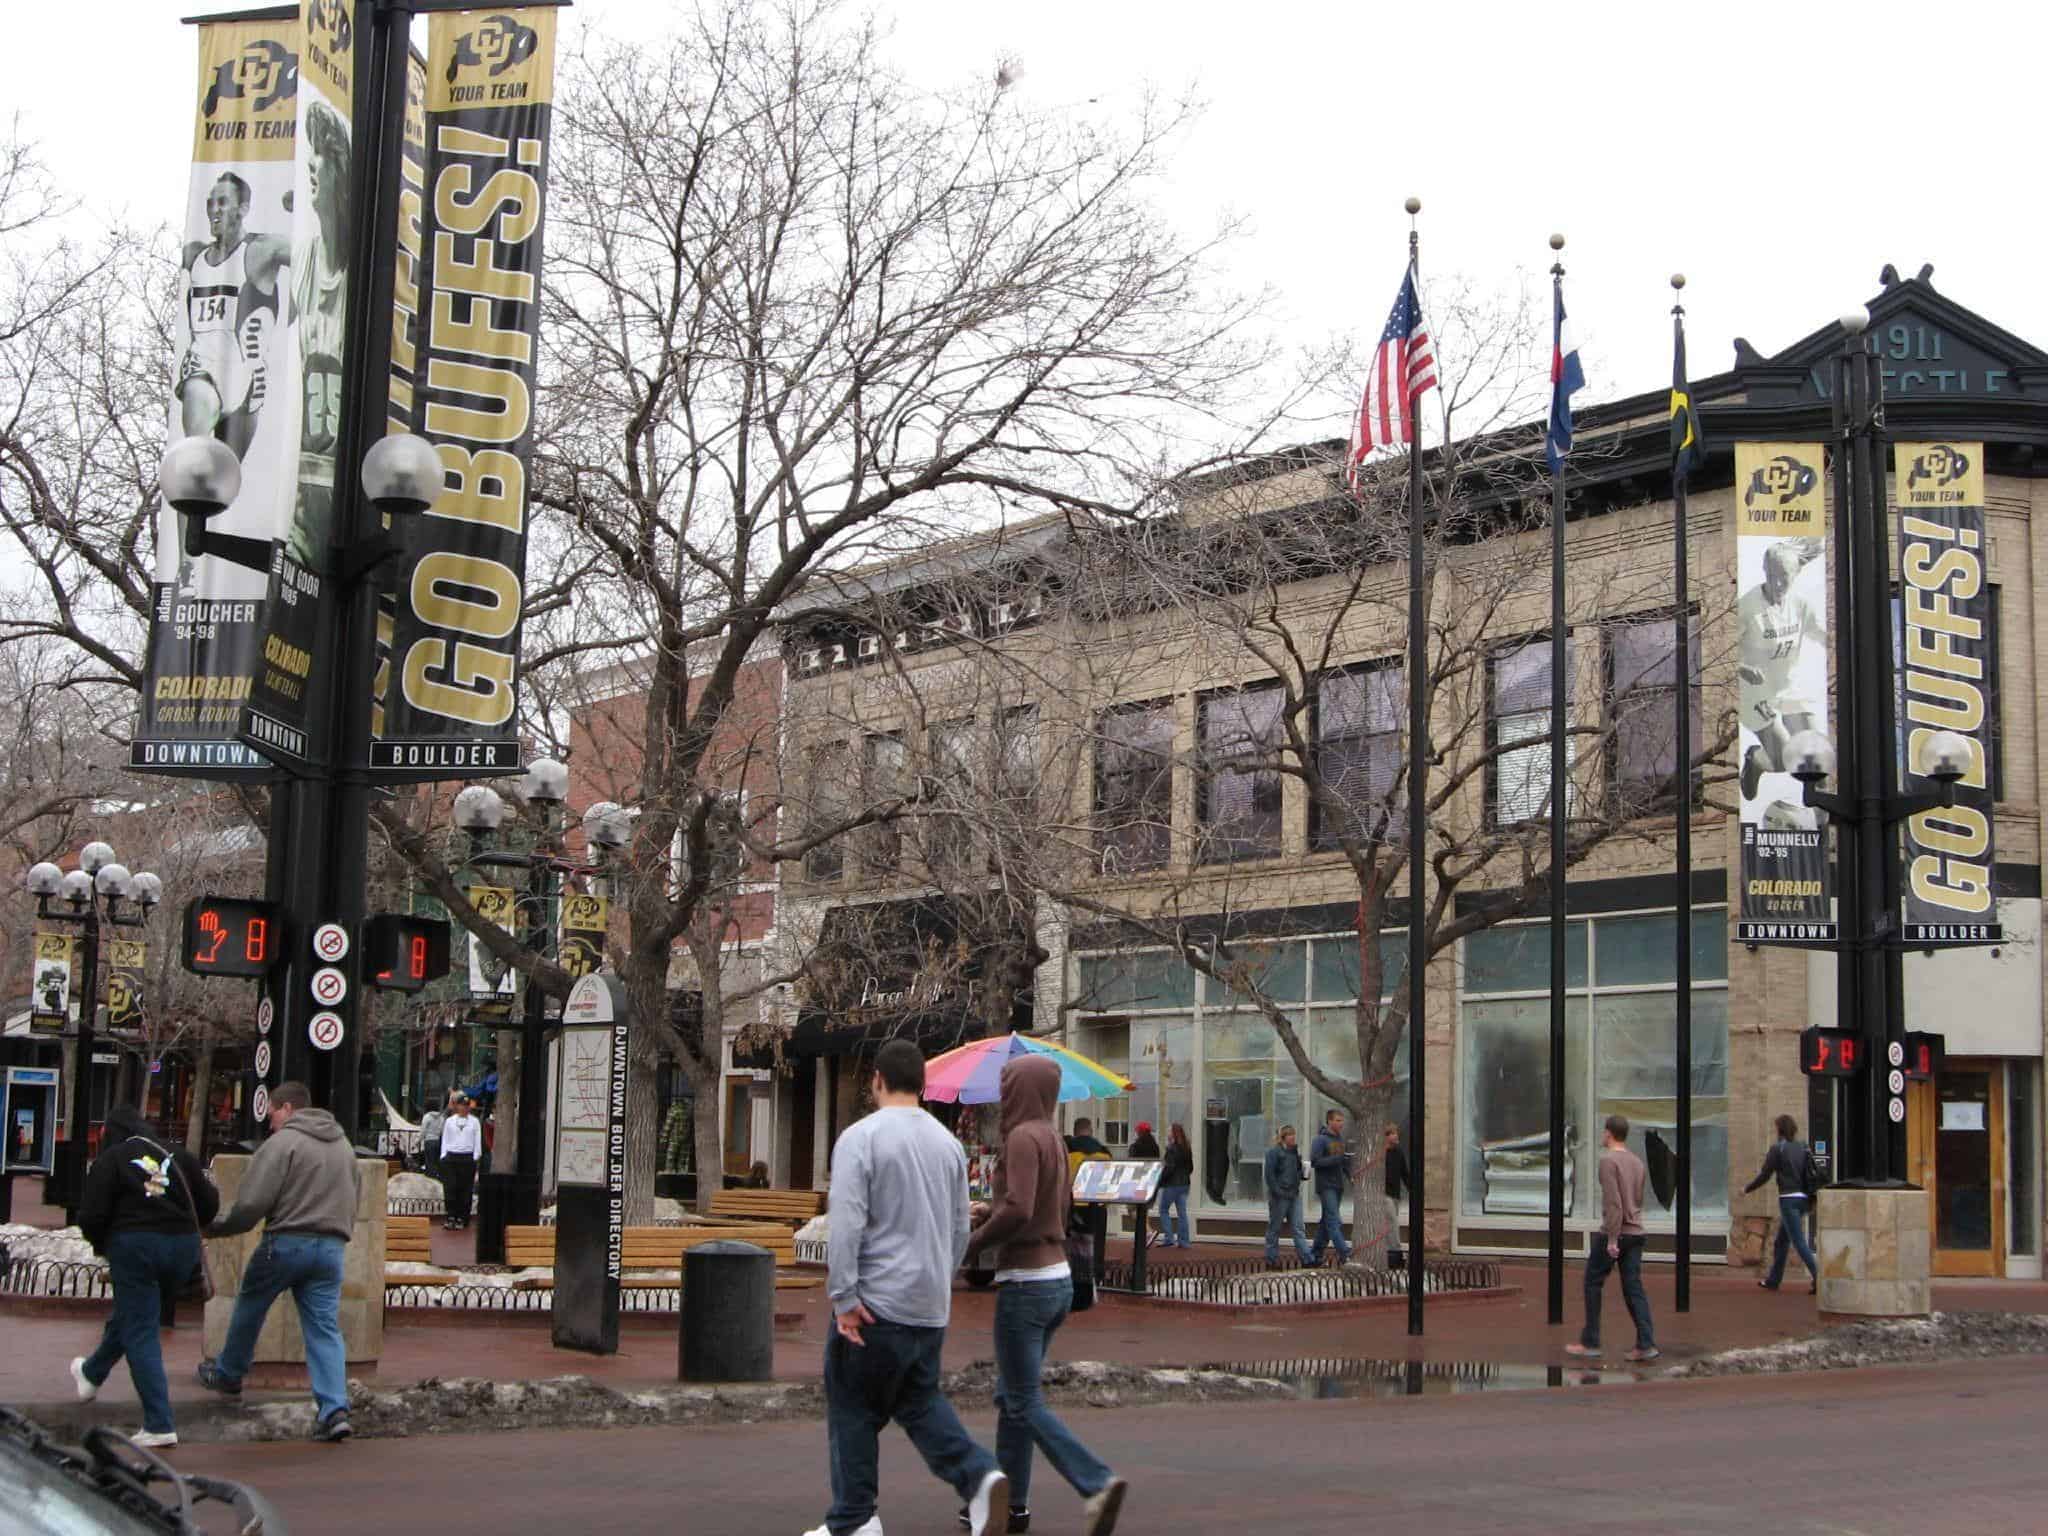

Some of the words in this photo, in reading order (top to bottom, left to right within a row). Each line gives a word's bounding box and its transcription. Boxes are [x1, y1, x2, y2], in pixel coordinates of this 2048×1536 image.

[308, 42, 329, 75] YOUR
[447, 83, 484, 103] YOUR
[490, 81, 527, 101] TEAM
[204, 121, 248, 141] YOUR
[253, 120, 296, 140] TEAM
[197, 297, 226, 322] 154
[424, 125, 542, 534] BUFFS!
[1872, 325, 1944, 360] 1911
[1908, 491, 1936, 503] YOUR
[1939, 491, 1965, 502] TEAM
[1747, 509, 1777, 523] YOUR
[1781, 508, 1812, 523] TEAM
[156, 586, 173, 622] adam
[175, 604, 256, 624] GOUCHER
[174, 625, 216, 640] '94-'98
[402, 551, 522, 726] GO
[264, 633, 312, 680] COLORADO
[158, 706, 196, 722] CROSS
[199, 706, 240, 722] COUNT
[251, 714, 303, 754] DOWNTOWN
[144, 744, 259, 764] DOWNTOWN
[392, 745, 497, 765] BOULDER
[1757, 832, 1820, 847] MUNNELLY
[1757, 847, 1788, 858] '02-'05
[1910, 804, 1992, 913] GO
[1749, 880, 1822, 896] COLORADO
[247, 919, 266, 961] 8
[1747, 924, 1828, 938] DOWNTOWN
[1918, 926, 1989, 939] BOULDER
[411, 936, 425, 978] 8
[610, 1125, 623, 1192] BOUDER
[608, 1200, 621, 1279] DIRECTORY
